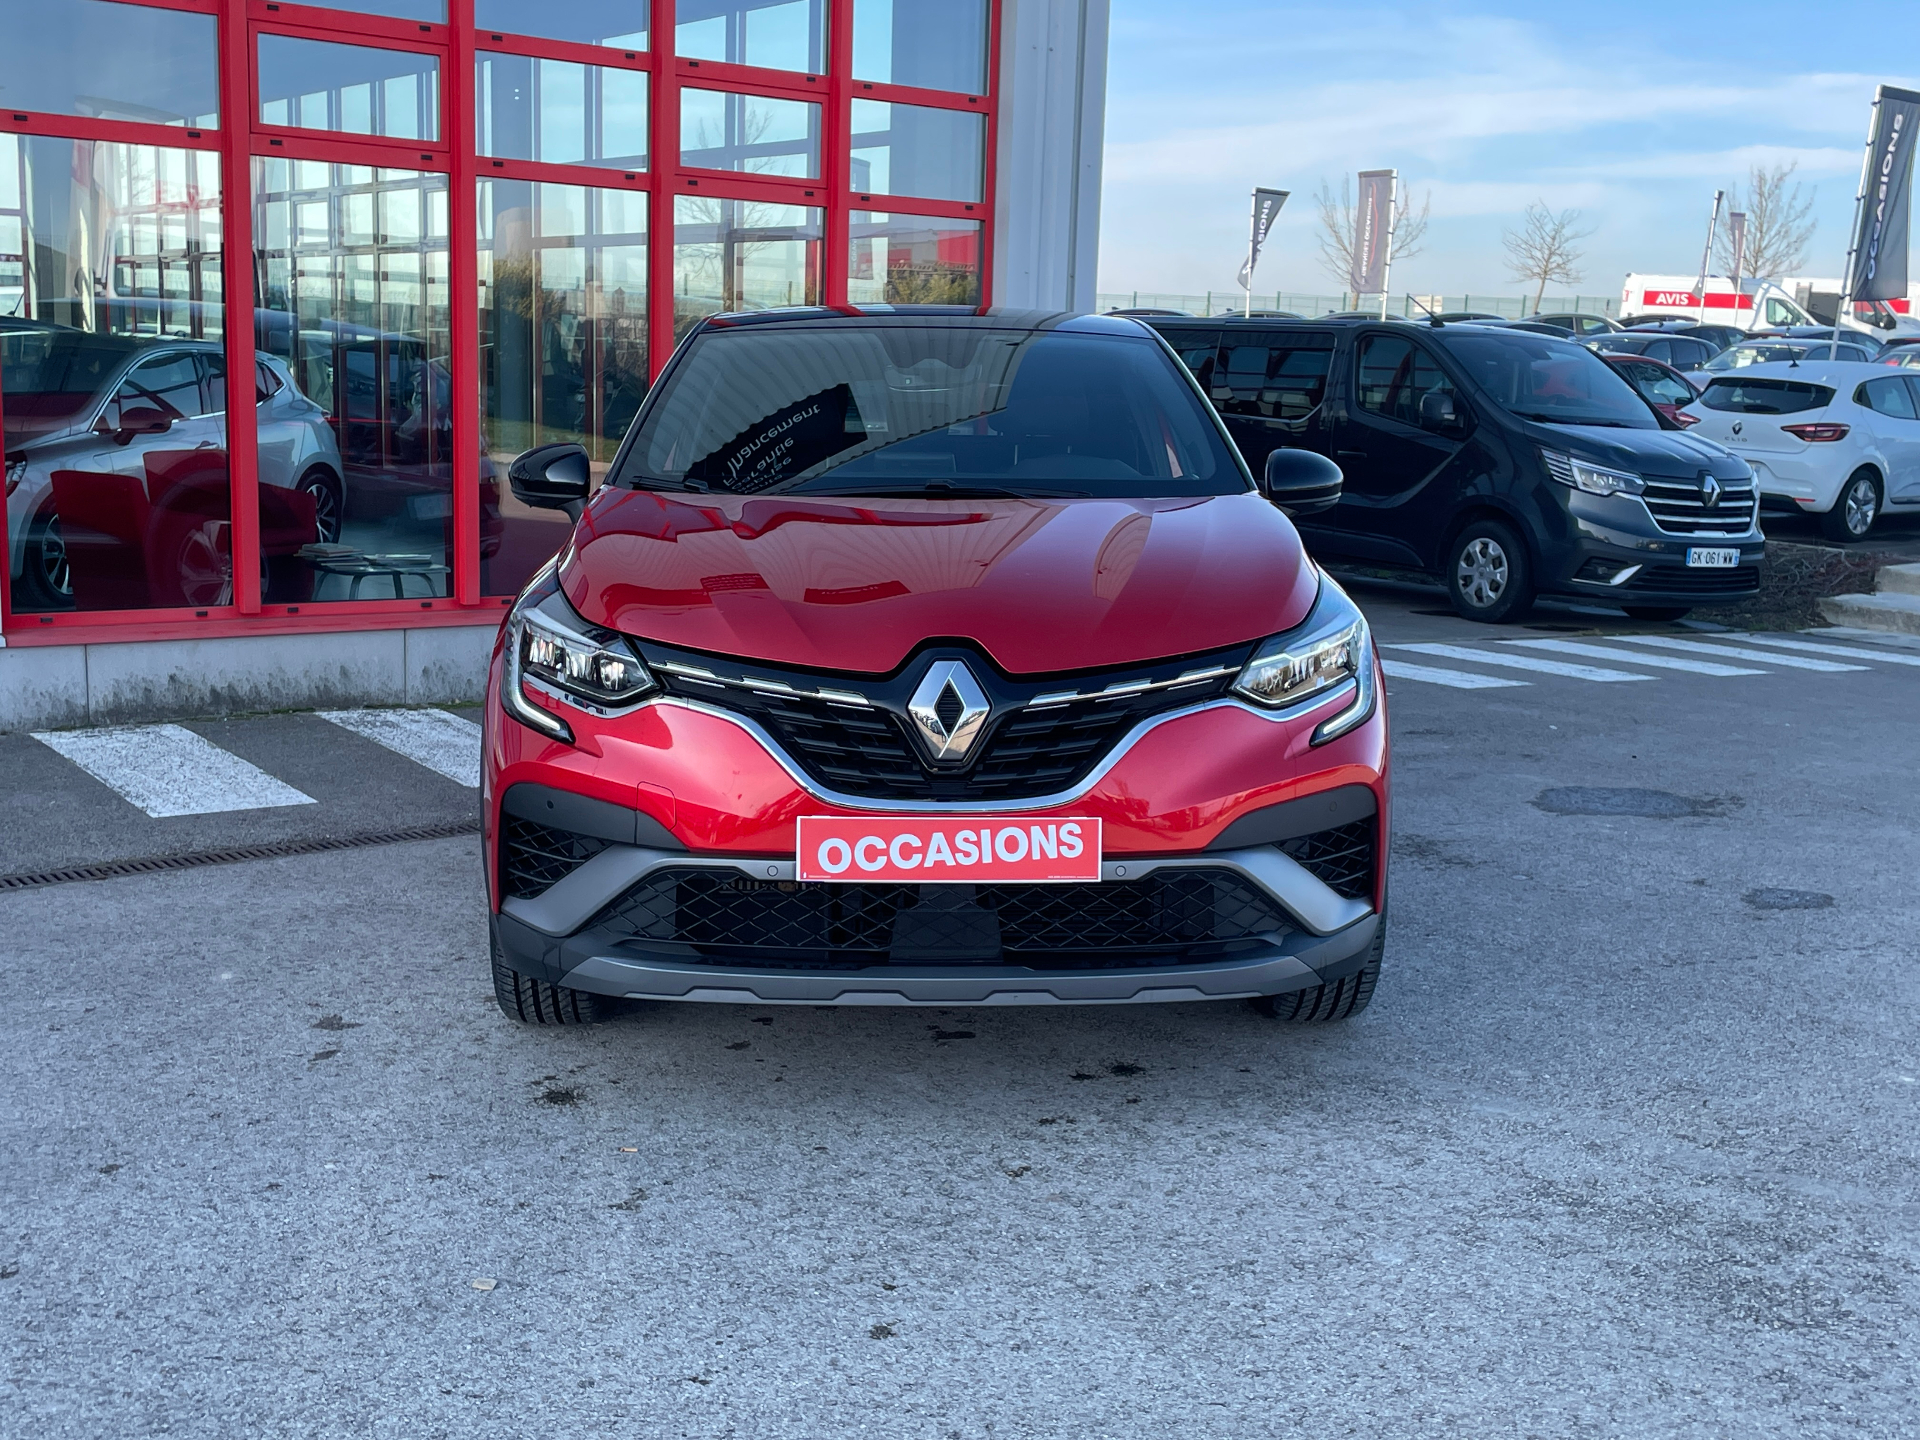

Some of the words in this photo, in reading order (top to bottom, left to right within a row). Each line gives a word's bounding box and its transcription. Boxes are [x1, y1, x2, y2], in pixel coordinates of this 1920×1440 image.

[1867, 113, 1904, 280] OCCASIONS
[1655, 292, 1690, 306] AVIS
[817, 822, 1084, 874] OCCASIONS
